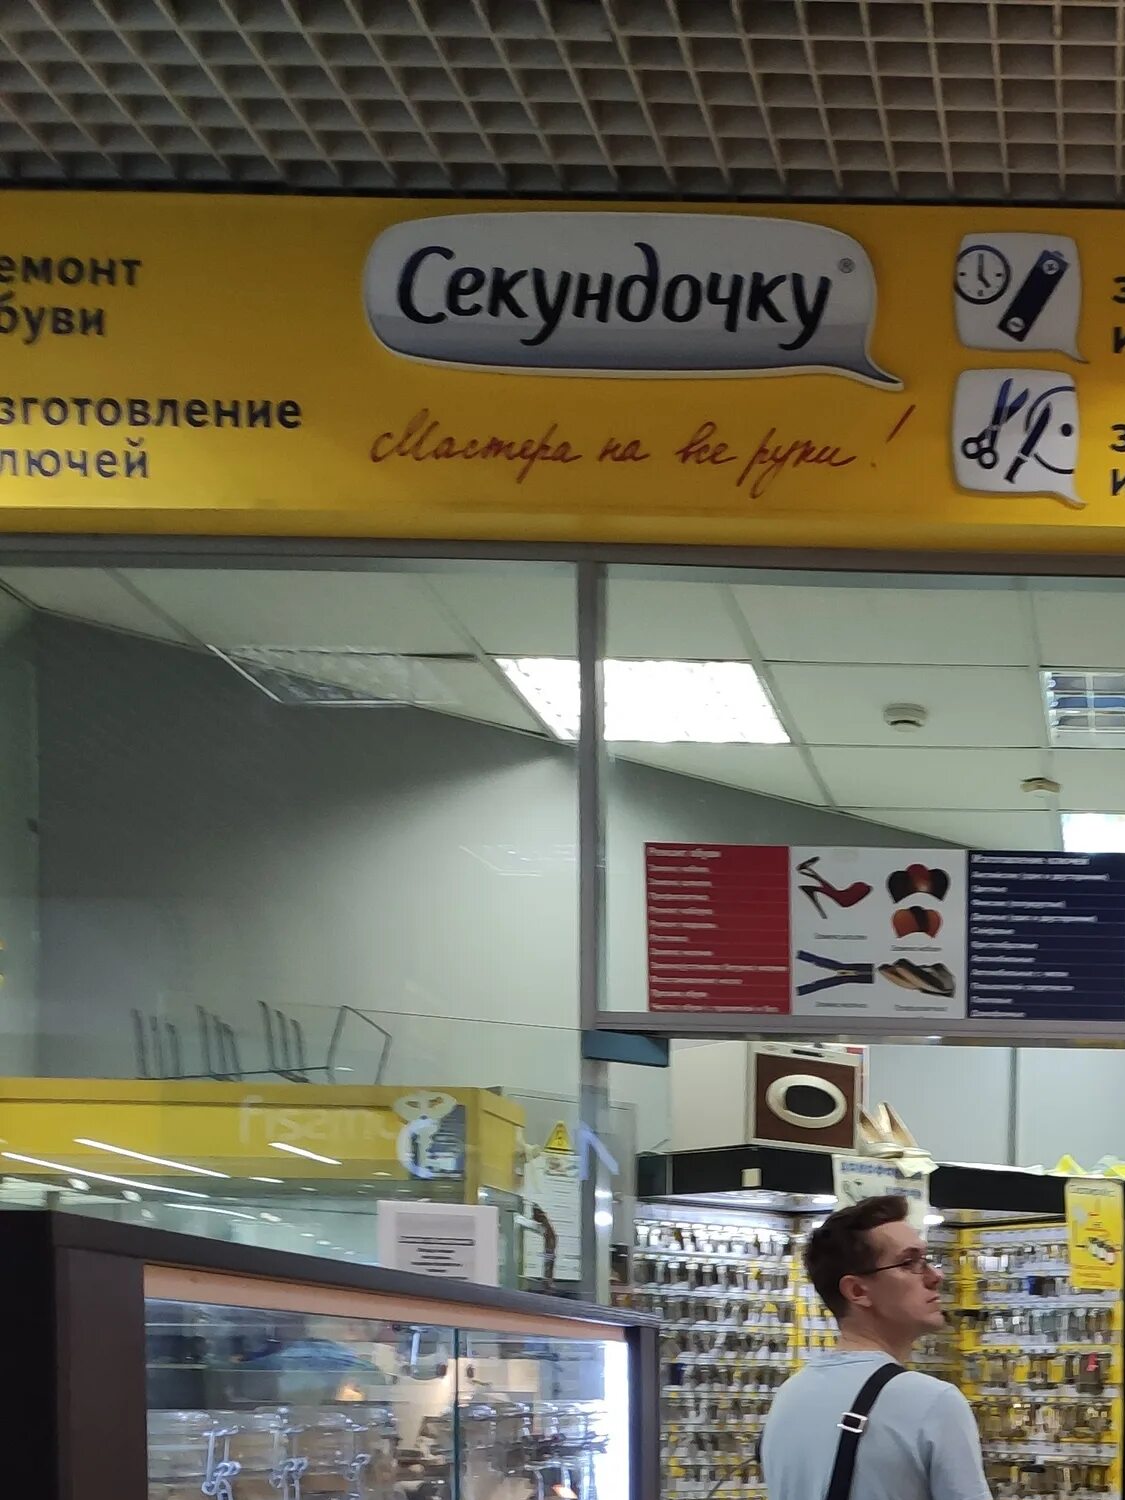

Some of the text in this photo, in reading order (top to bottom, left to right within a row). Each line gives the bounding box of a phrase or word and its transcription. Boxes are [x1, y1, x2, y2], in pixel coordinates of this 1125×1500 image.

[0, 255, 143, 287] емонт
[0, 290, 106, 345] буви
[396, 242, 832, 351] Секундочку
[0, 396, 302, 429] зготовление
[0, 437, 150, 479] лючей
[370, 408, 583, 484] Мастера
[598, 437, 651, 463] на
[675, 421, 738, 465] все
